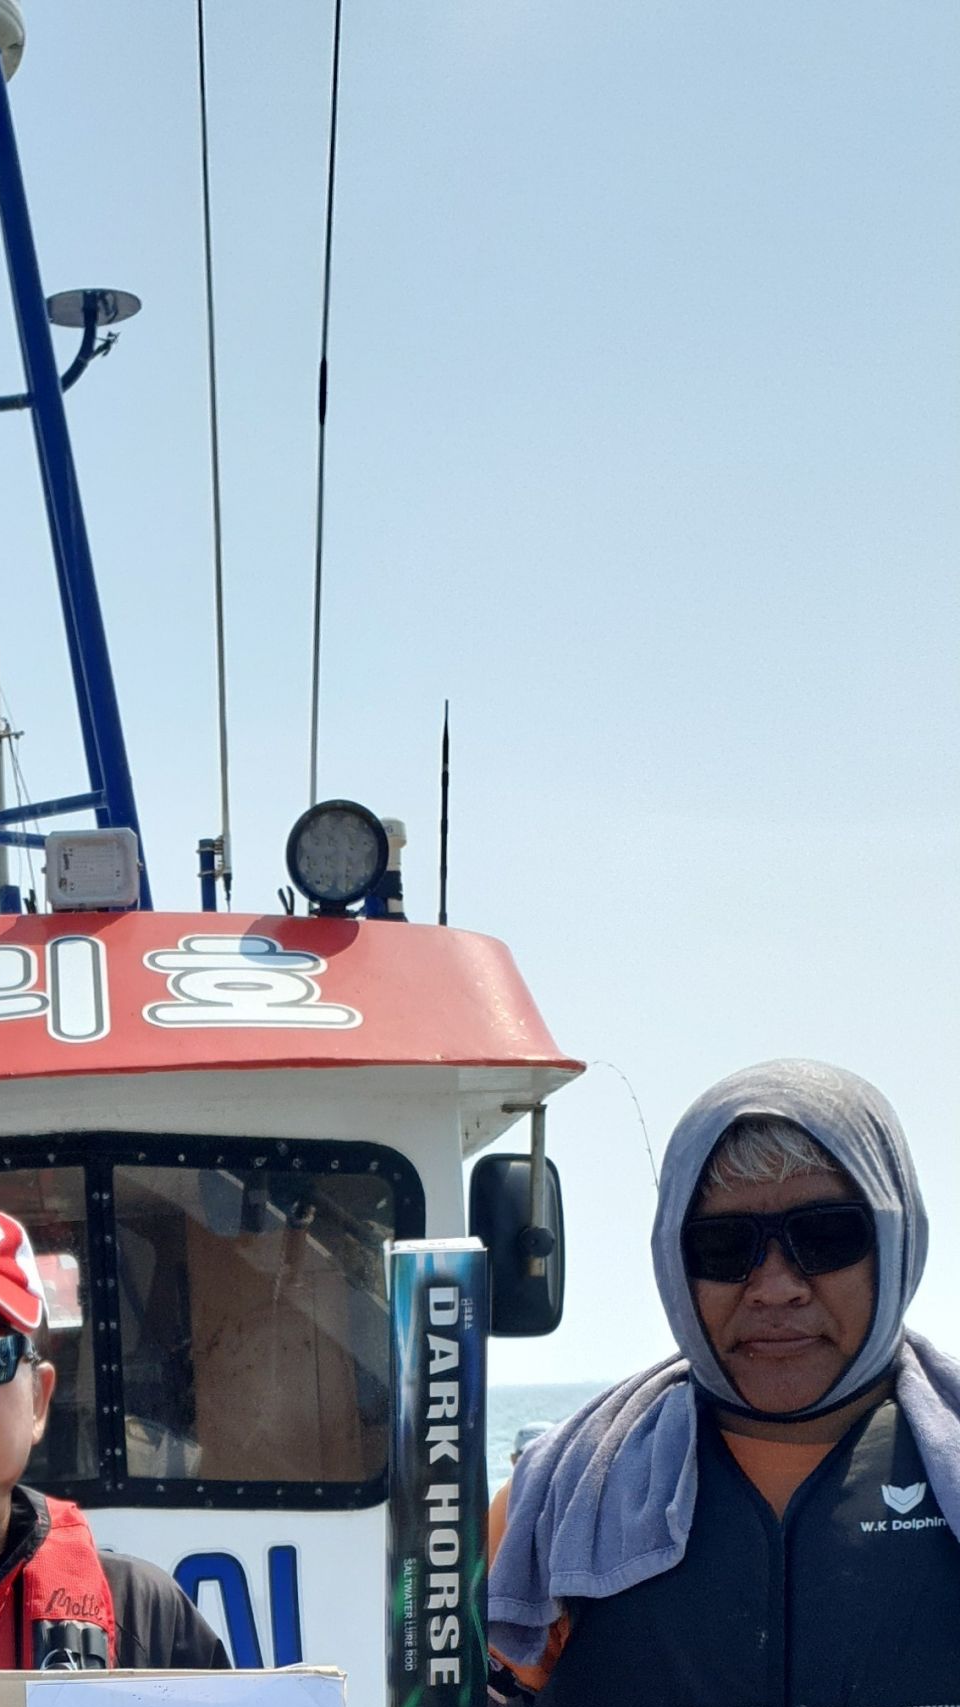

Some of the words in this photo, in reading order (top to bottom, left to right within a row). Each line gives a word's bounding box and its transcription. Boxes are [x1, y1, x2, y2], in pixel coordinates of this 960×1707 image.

[425, 1286, 460, 1465] DARK
[860, 1521, 887, 1532] W.K
[891, 1516, 946, 1531] Dolphin
[403, 1558, 414, 1618] SALTWATER
[424, 1483, 460, 1686] HORSE
[403, 1620, 414, 1647] LURE
[403, 1649, 414, 1671] ROD
